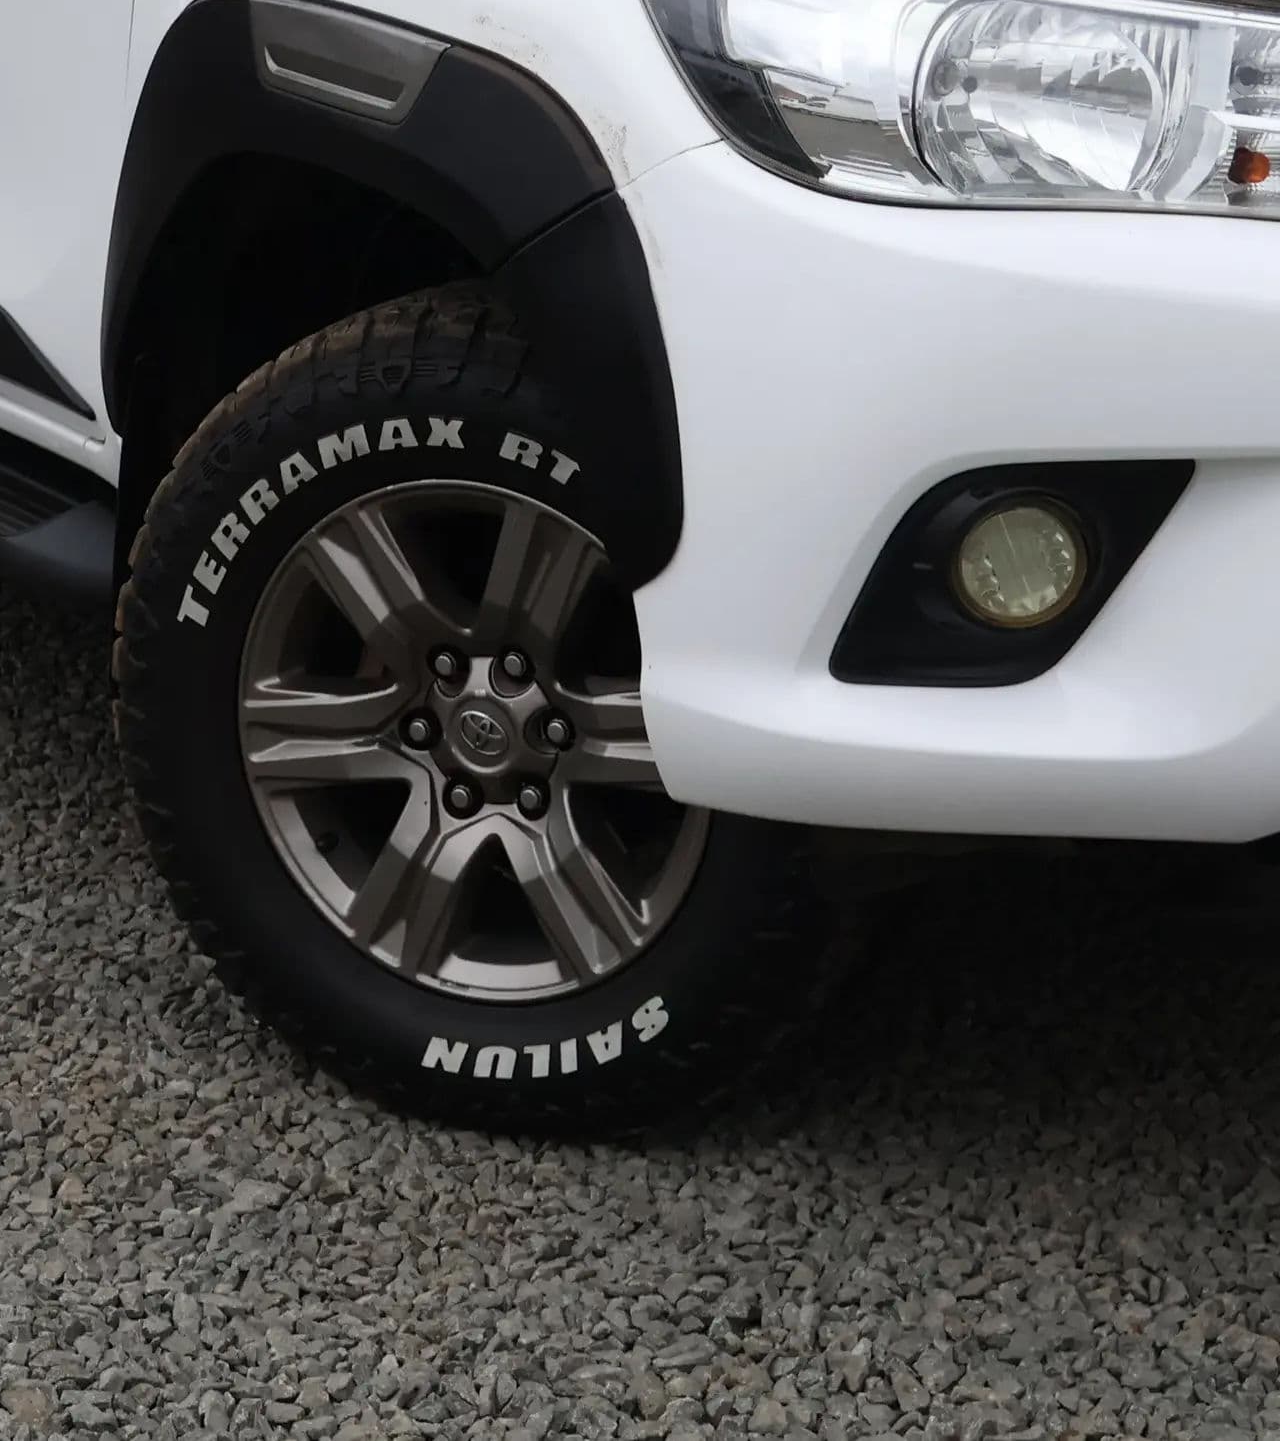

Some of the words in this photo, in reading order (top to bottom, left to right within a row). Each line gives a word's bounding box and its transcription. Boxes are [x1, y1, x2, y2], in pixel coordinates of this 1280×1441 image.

[177, 416, 466, 629] TERRAMAX
[497, 431, 582, 486] RT
[421, 995, 670, 1079] SAILUN
